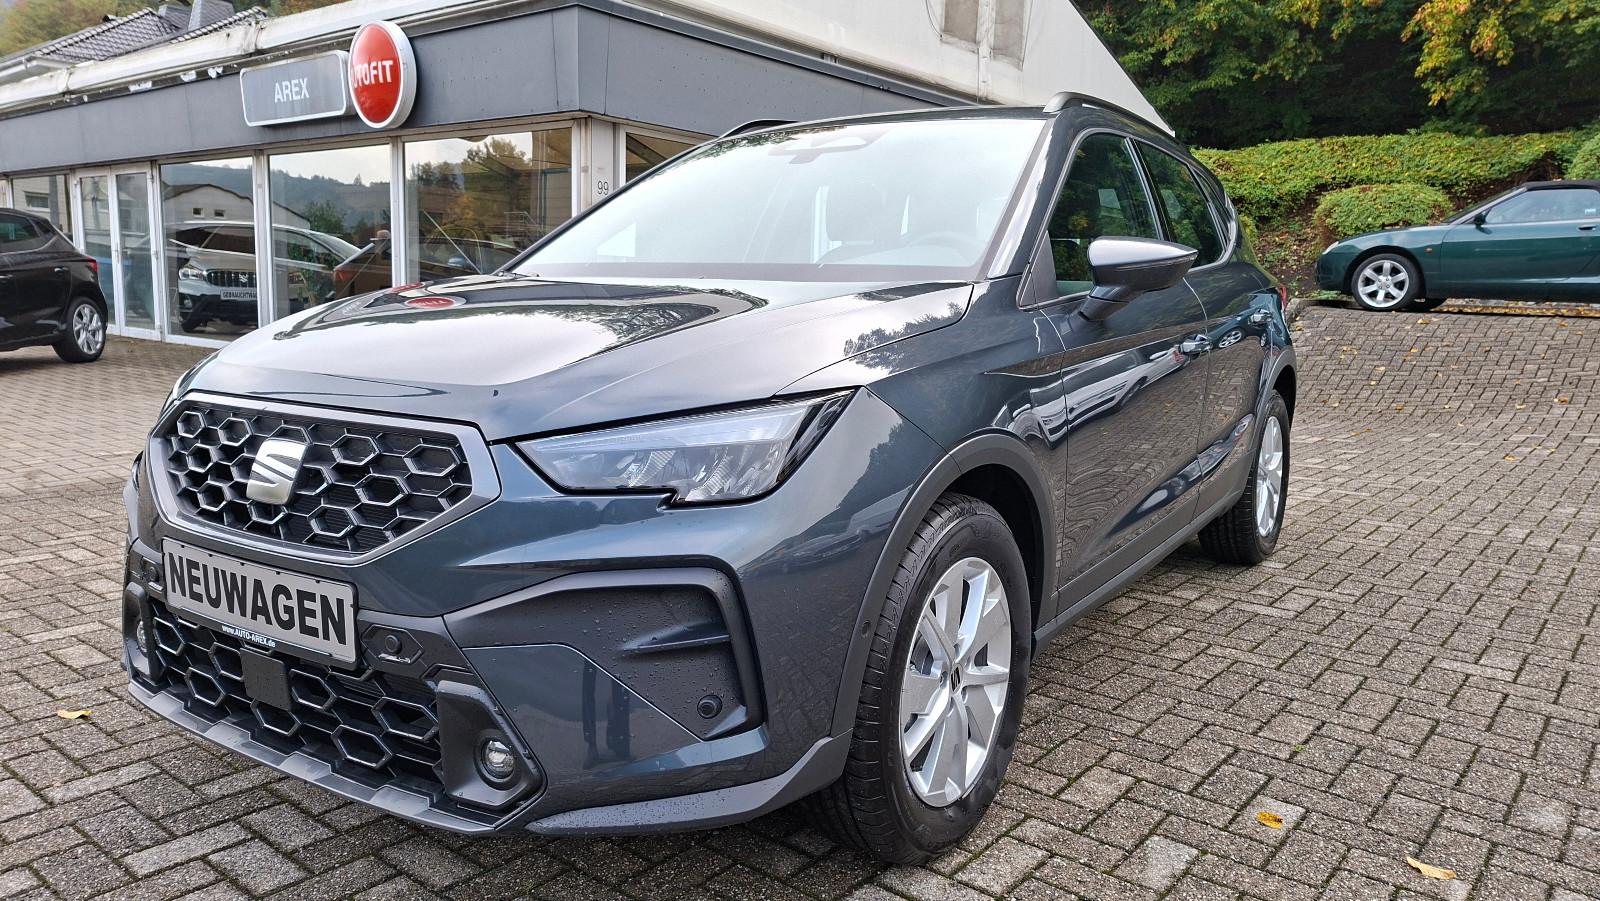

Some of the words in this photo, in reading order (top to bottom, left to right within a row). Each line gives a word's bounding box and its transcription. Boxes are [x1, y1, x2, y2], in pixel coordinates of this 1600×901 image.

[274, 77, 310, 103] AREX
[597, 180, 609, 196] 99
[168, 552, 347, 645] NEUWAGEN
[221, 625, 276, 648] www.AUTO-AREX.de
